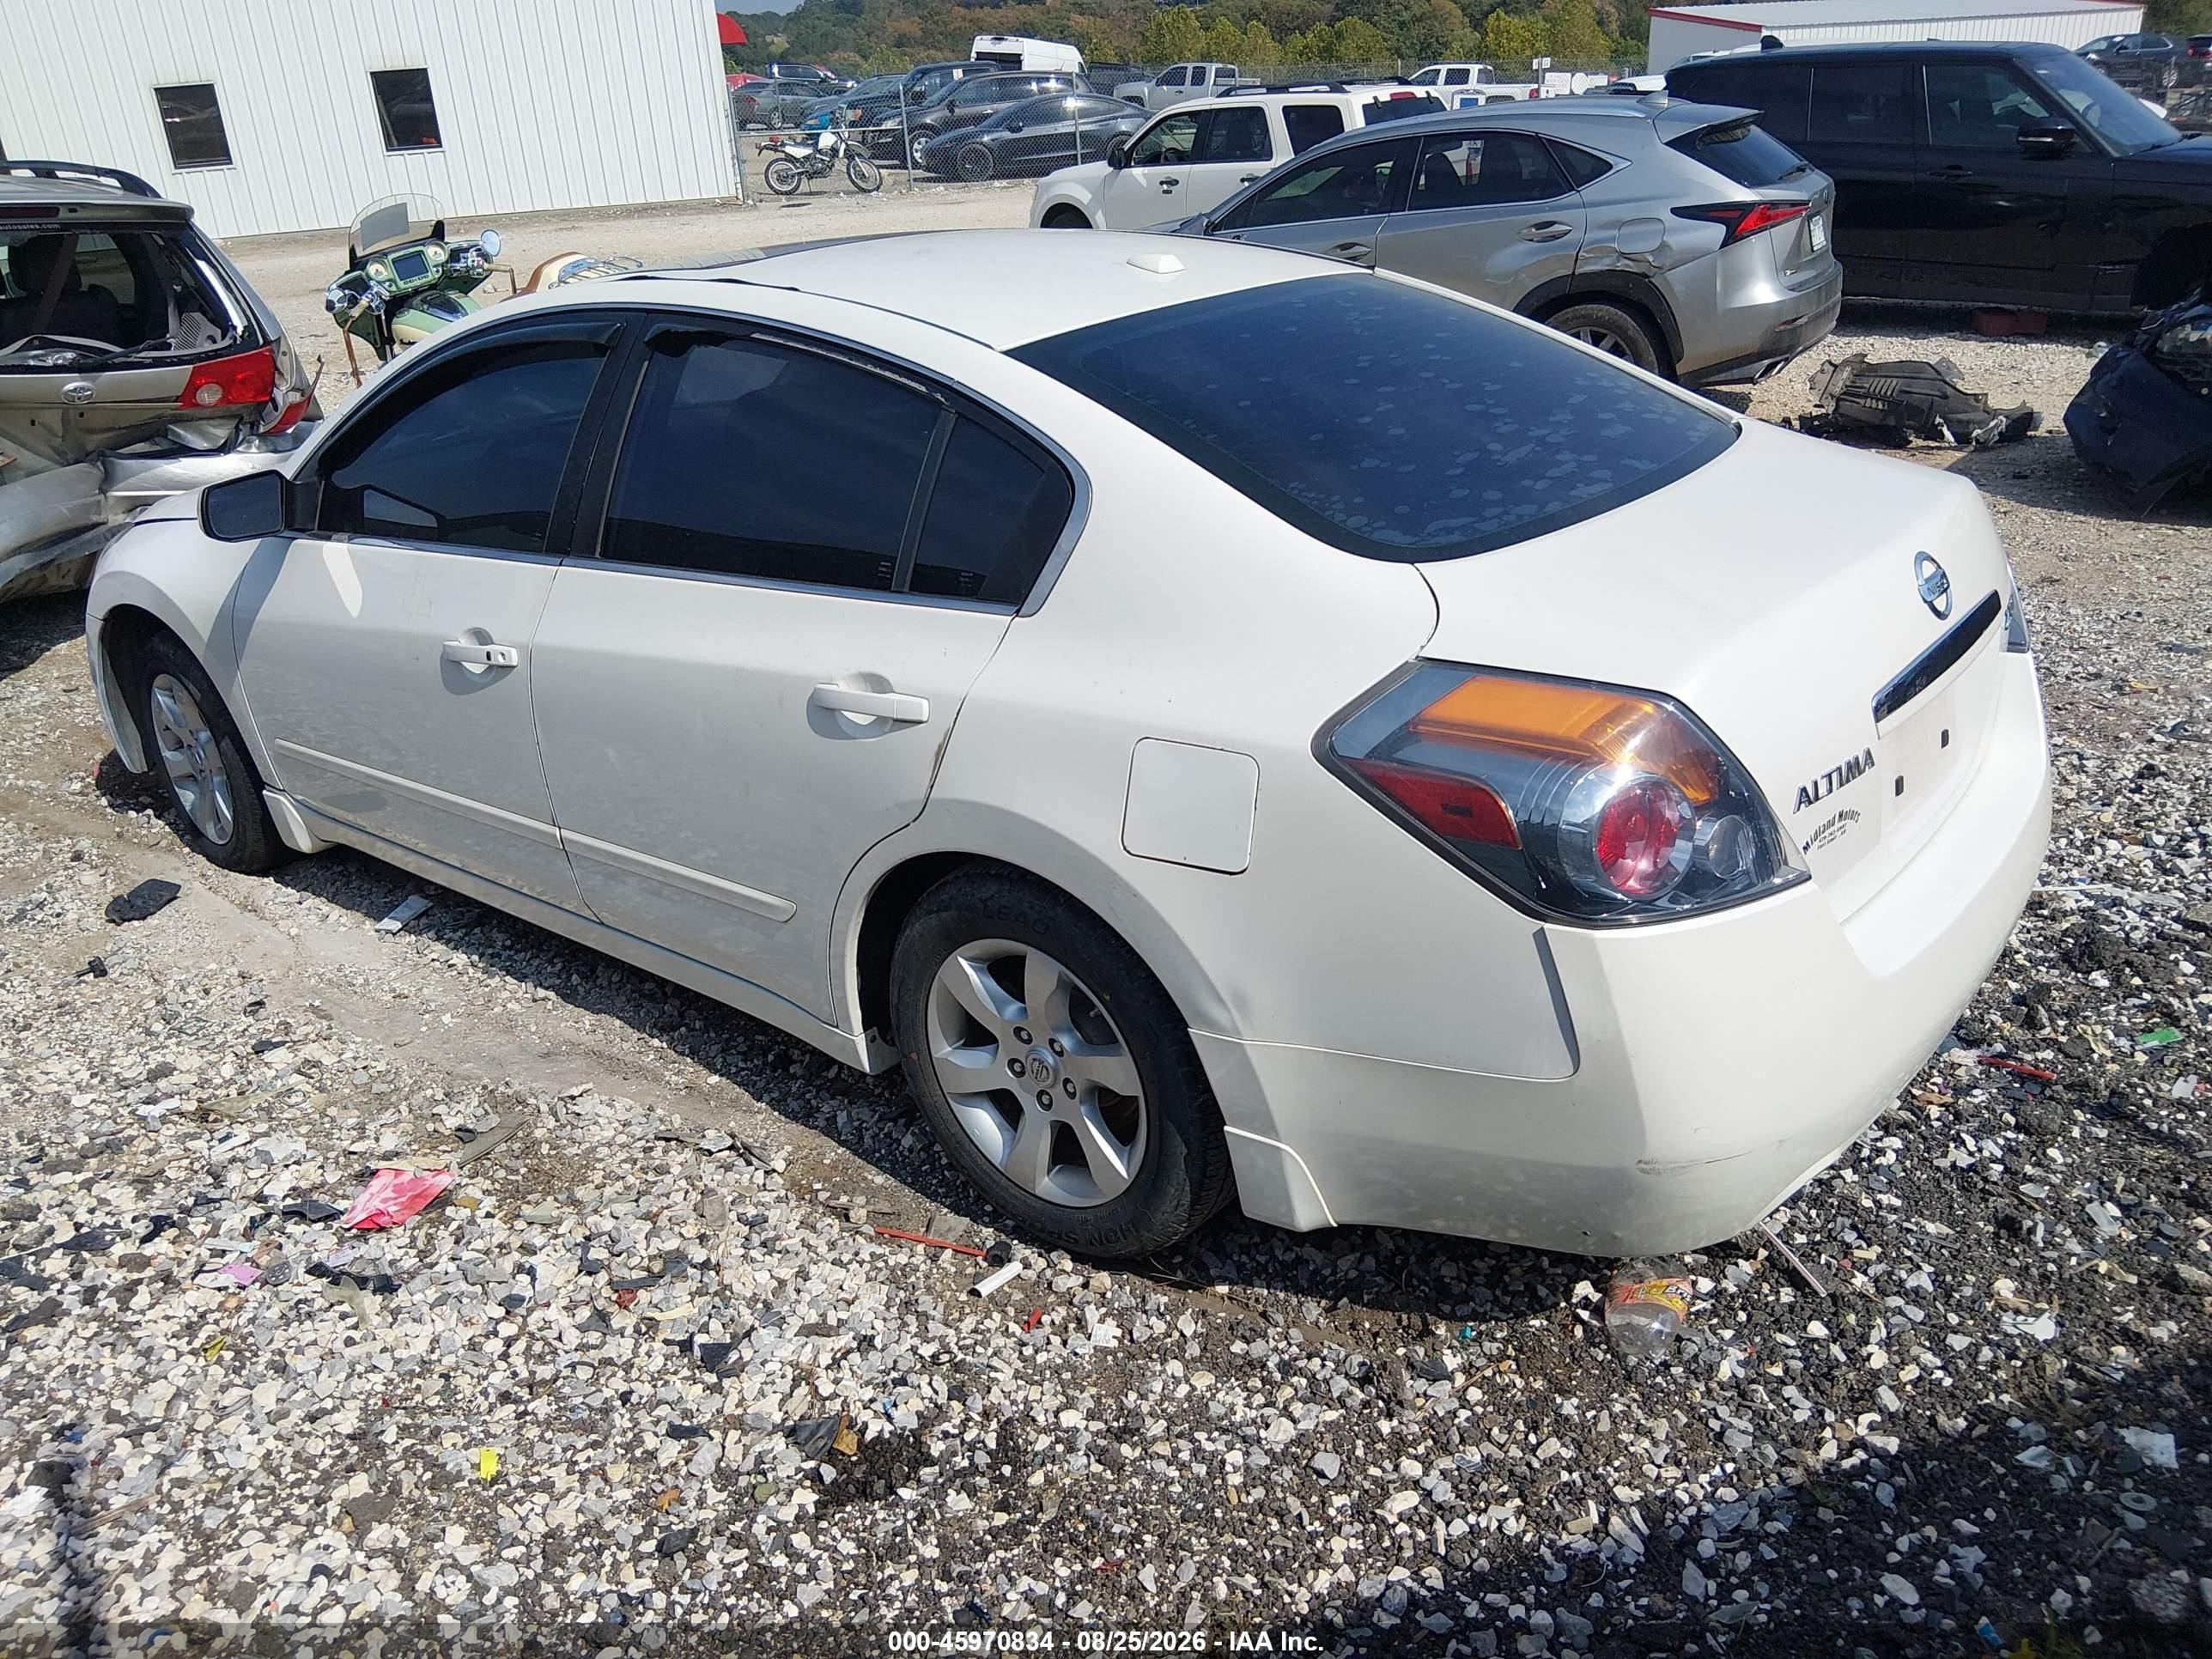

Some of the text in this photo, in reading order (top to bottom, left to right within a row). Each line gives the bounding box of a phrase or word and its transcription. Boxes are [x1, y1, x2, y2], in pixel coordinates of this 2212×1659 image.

[1793, 747, 1875, 815] ALTIMA
[1802, 808, 1860, 855] Midland Motors
